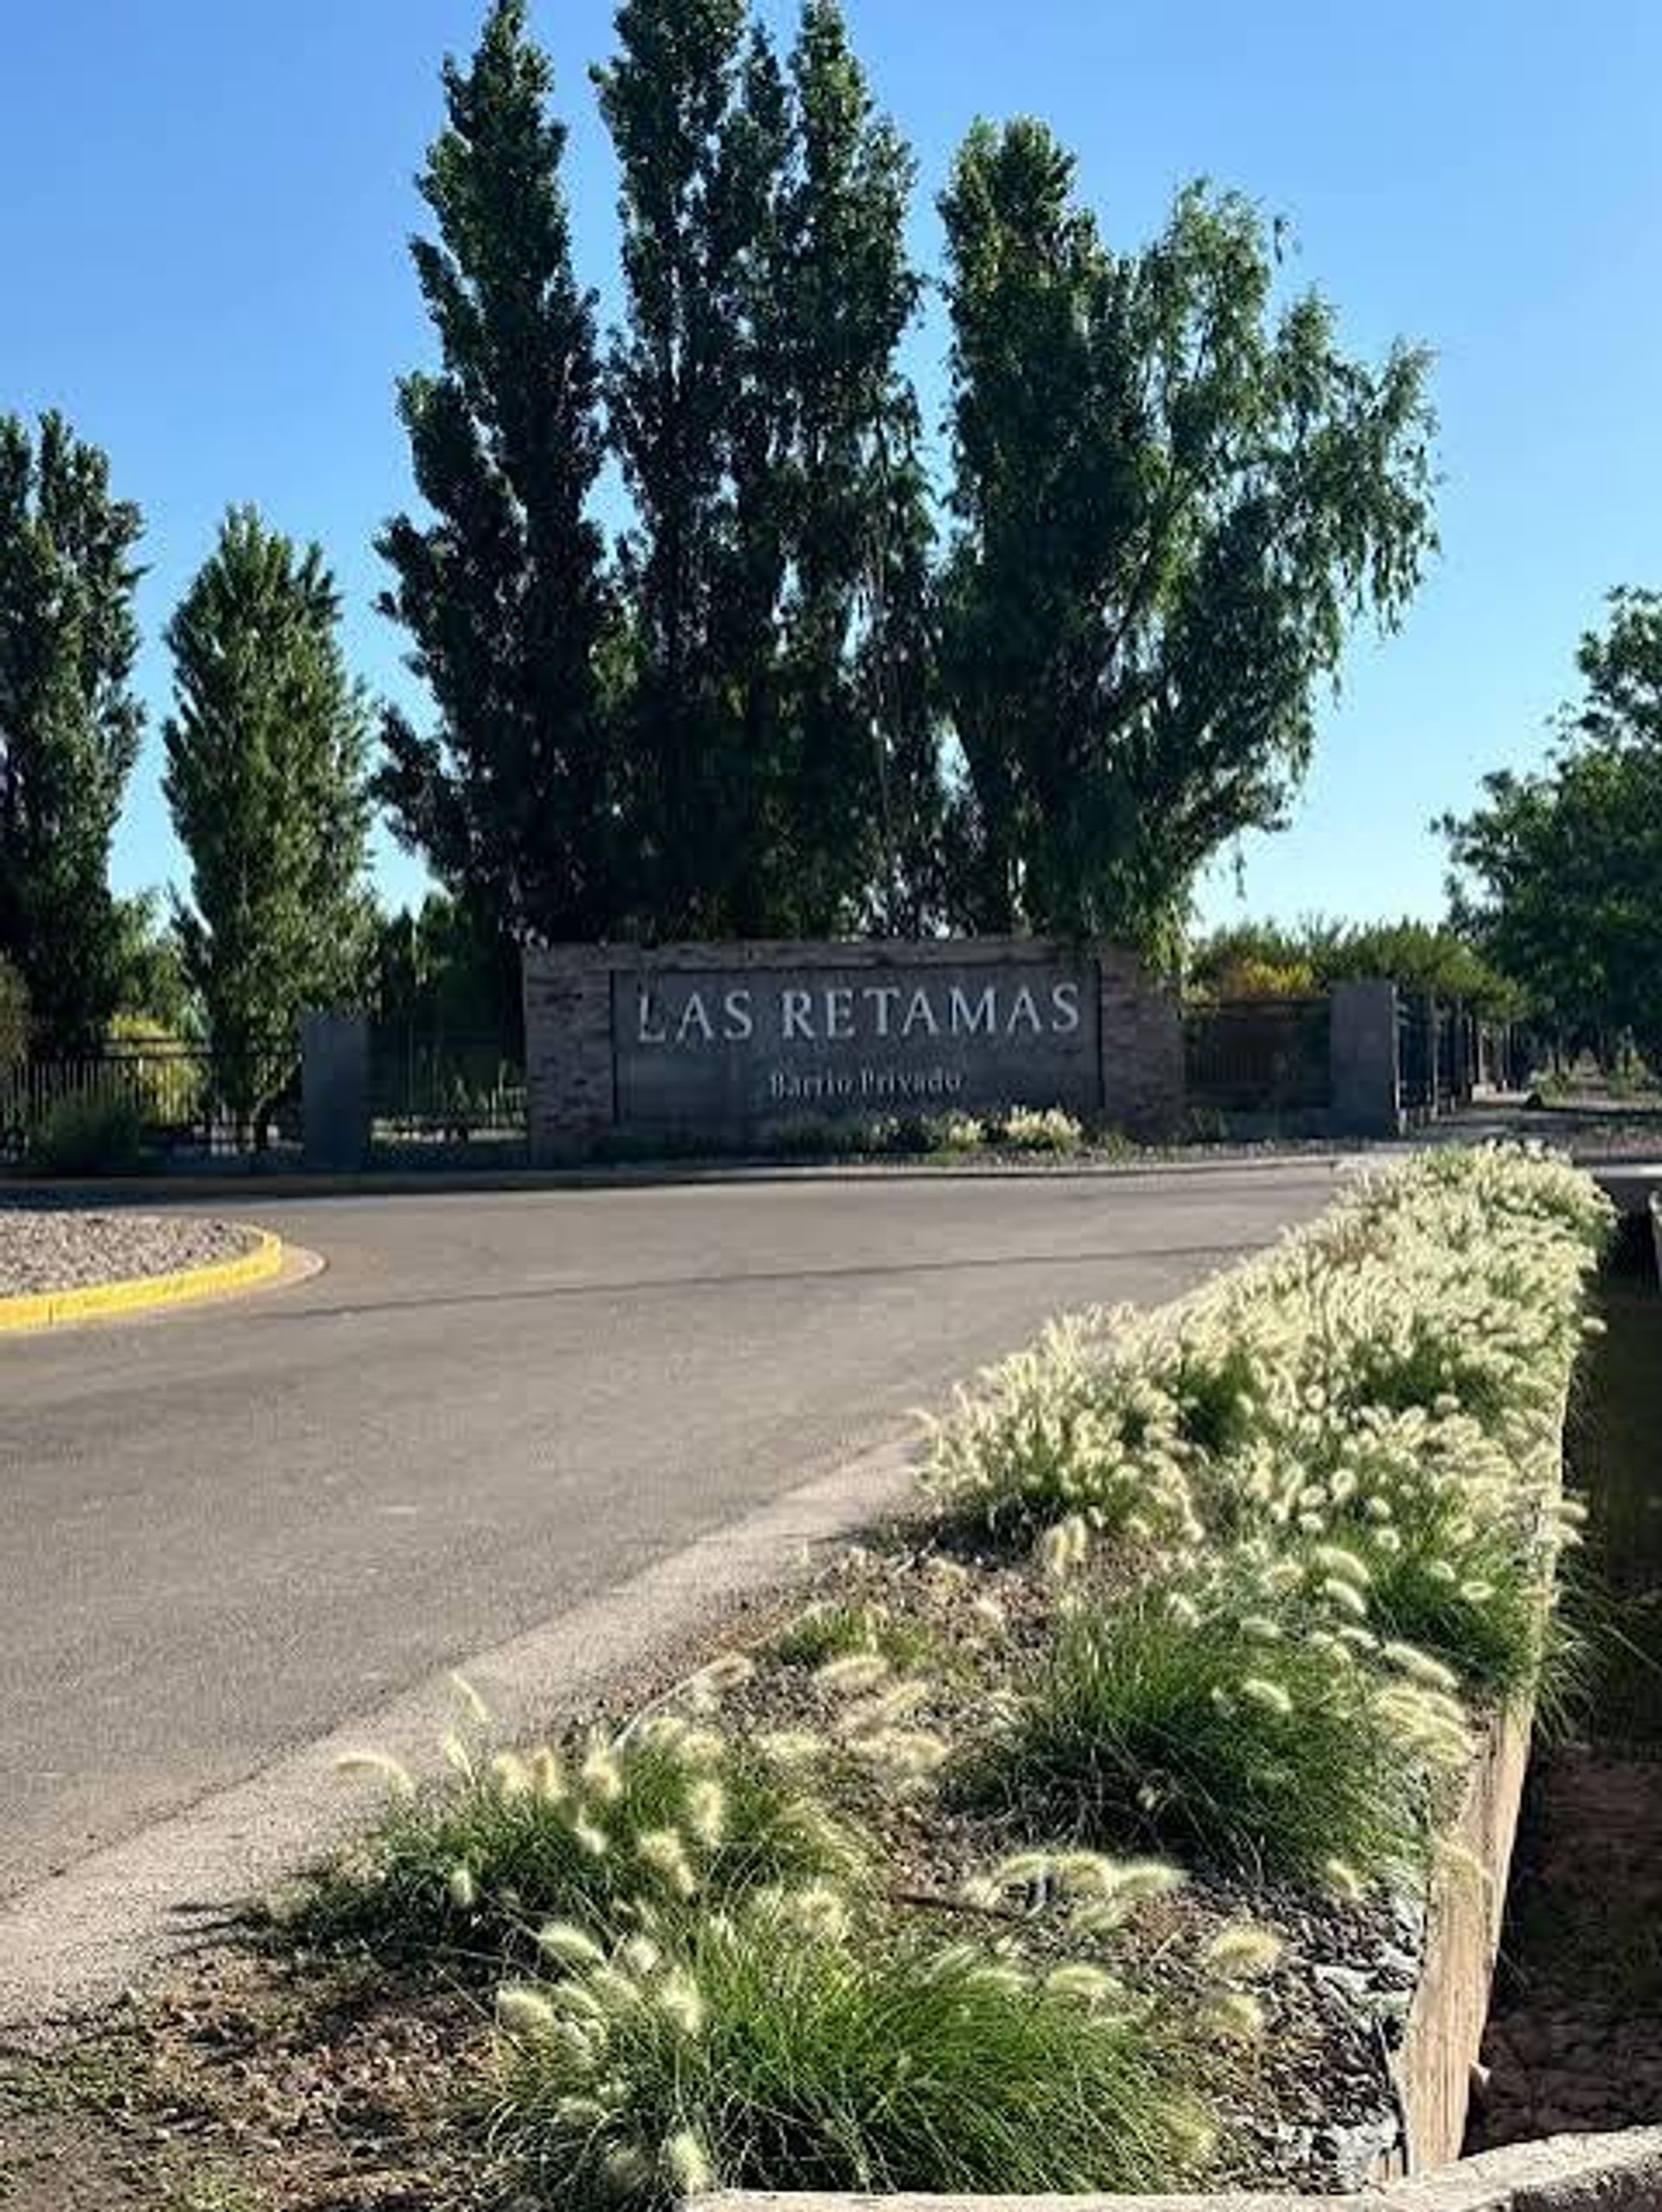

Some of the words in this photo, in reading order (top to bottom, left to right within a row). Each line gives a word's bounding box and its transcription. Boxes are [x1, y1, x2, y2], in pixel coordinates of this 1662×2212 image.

[637, 988, 753, 1044] LAS
[781, 981, 1081, 1039] RETAMAS
[770, 1070, 851, 1098] Barrio
[860, 1066, 963, 1096] Privado
